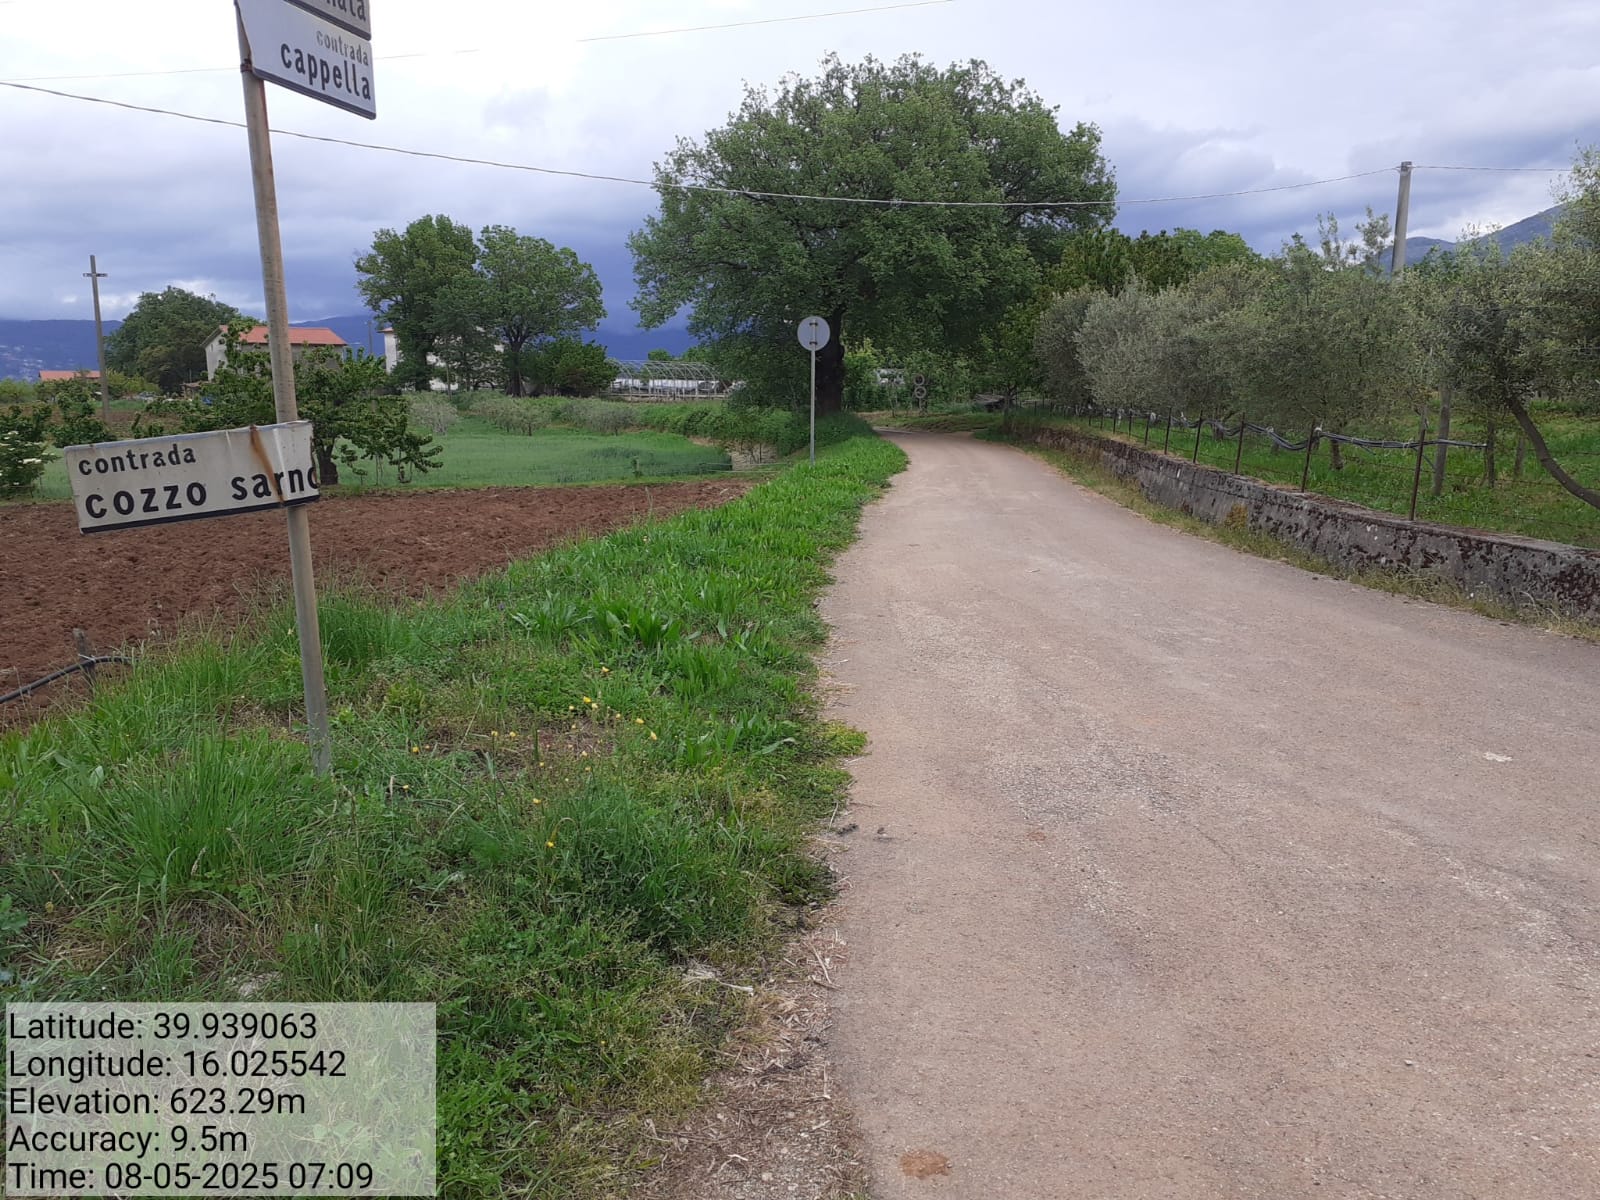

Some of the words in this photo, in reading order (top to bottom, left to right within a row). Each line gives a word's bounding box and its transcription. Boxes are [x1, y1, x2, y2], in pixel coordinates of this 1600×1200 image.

[316, 30, 368, 66] contrada
[281, 43, 371, 100] cappella
[78, 444, 196, 475] contrada
